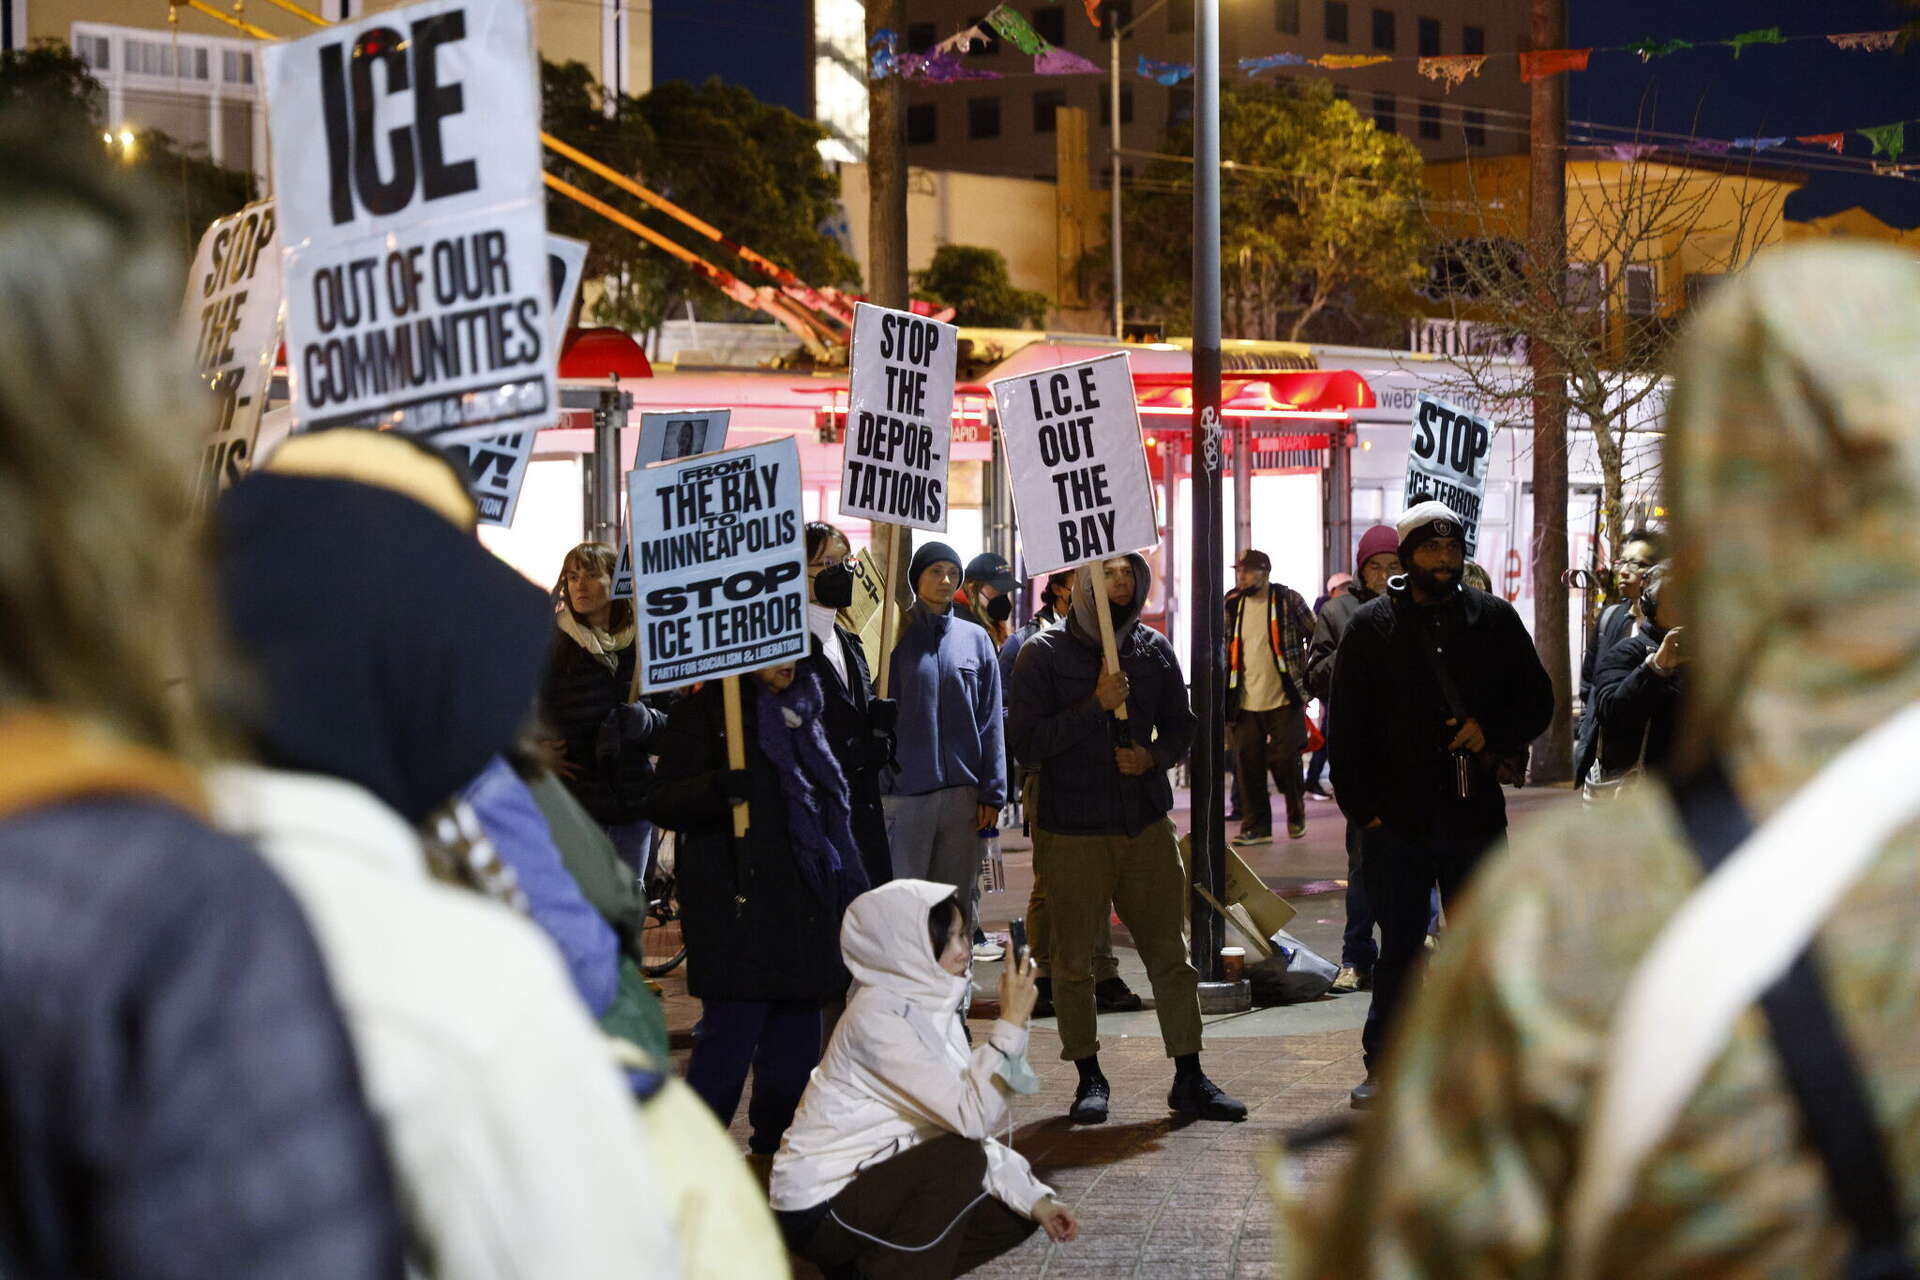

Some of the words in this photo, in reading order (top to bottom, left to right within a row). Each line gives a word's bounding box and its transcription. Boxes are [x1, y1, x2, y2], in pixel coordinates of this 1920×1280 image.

[319, 9, 479, 226] ICE
[203, 207, 276, 298] STOP
[313, 255, 383, 333] OUT
[387, 245, 425, 317] OF
[432, 230, 511, 303] OUR
[303, 298, 543, 409] COMMUNITIES
[880, 313, 939, 368] STOP
[885, 366, 928, 417] THE
[1029, 367, 1101, 421] I.C.E
[857, 410, 941, 471] DEPOR-
[952, 425, 978, 442] APID
[1038, 416, 1095, 468] OUT
[1414, 401, 1489, 477] STOP
[656, 478, 716, 531] THE
[721, 463, 780, 514] BAY
[682, 458, 753, 483] FROM
[848, 460, 942, 524] TATIONS
[1052, 464, 1113, 515] THE
[1409, 470, 1431, 495] ICE
[1433, 479, 1480, 521] TERROR
[641, 509, 796, 575] MINNEAPOLIS
[703, 513, 738, 529] TO
[1058, 510, 1116, 563] BAY
[646, 560, 802, 617] STOP
[648, 616, 694, 661] ICE
[697, 592, 803, 651] TERROR
[651, 665, 680, 681] PARTY
[744, 650, 755, 662] &
